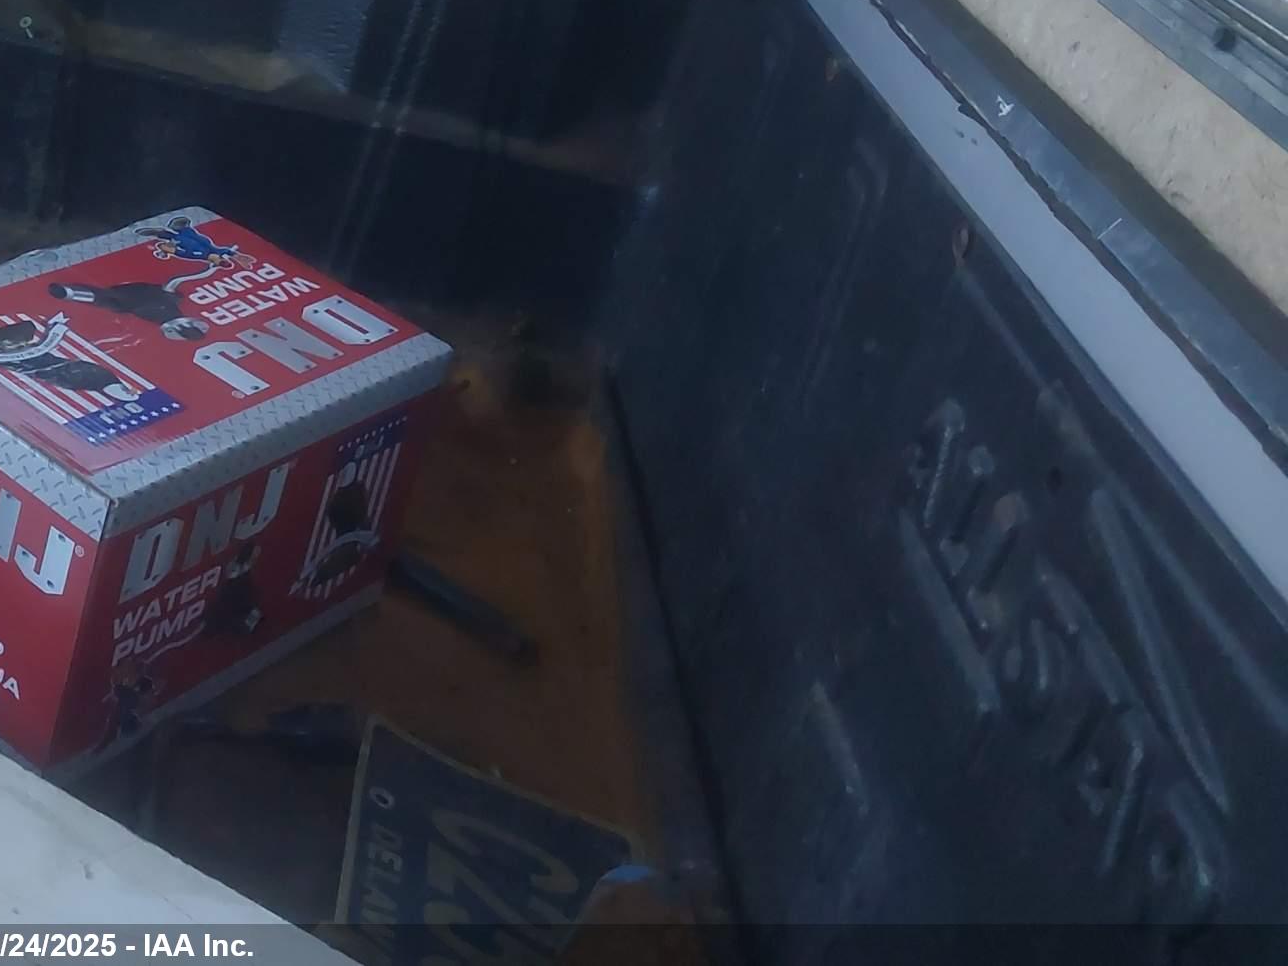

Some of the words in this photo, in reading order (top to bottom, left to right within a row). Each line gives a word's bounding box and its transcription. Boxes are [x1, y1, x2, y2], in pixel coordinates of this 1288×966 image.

[188, 262, 286, 305] PUMP
[200, 277, 321, 326] WATER
[193, 294, 399, 396] DNJ
[118, 462, 290, 604] DNJ
[112, 600, 206, 667] PUMP
[113, 566, 222, 638] WATER
